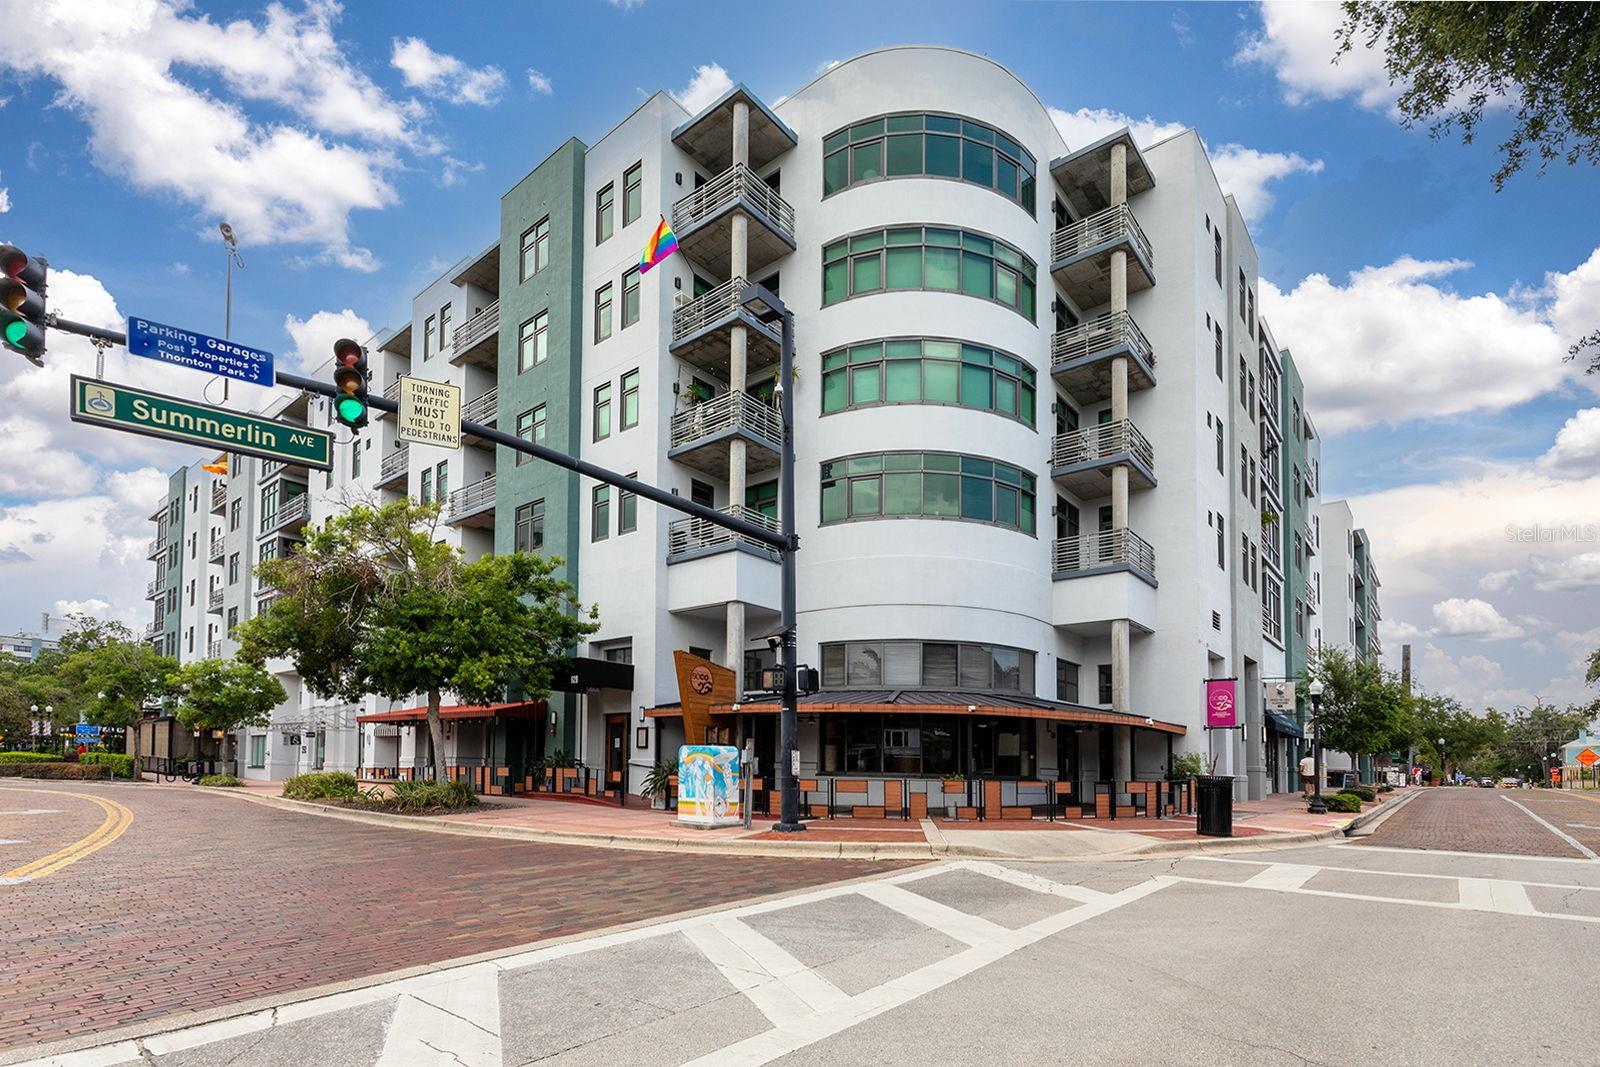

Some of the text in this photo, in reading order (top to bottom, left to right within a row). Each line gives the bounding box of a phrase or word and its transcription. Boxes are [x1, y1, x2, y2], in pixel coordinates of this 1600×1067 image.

[136, 320, 266, 362] Parking Garages
[157, 339, 249, 369] Post Properties
[158, 349, 246, 378] Thornton Park
[411, 383, 450, 399] TURNING
[411, 394, 449, 409] TRAFFIC
[414, 405, 446, 420] MUST
[132, 399, 315, 448] Summerlin AVE
[409, 417, 451, 432] YIELD TO
[400, 426, 458, 444] PEDESTRIANS
